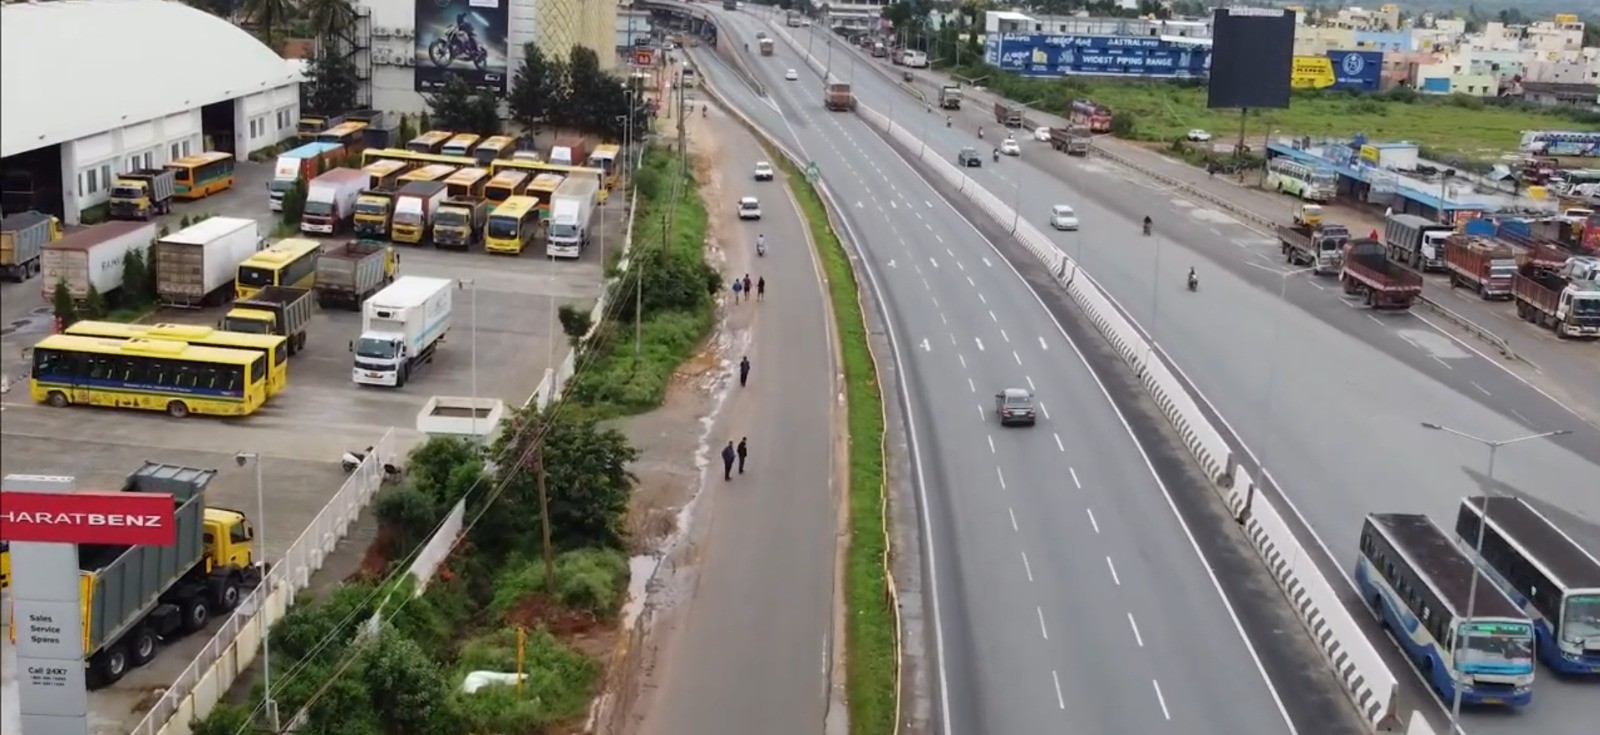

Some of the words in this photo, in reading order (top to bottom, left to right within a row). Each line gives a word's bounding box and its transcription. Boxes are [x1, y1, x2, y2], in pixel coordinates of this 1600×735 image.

[1114, 38, 1141, 46] ASTRAL
[1082, 55, 1113, 65] WIDEST
[1116, 57, 1143, 65] PIPING
[1145, 58, 1173, 67] RANGE
[29, 614, 53, 623] Sales
[30, 624, 61, 634] Service
[31, 635, 60, 644] Spares
[28, 666, 44, 675] Call
